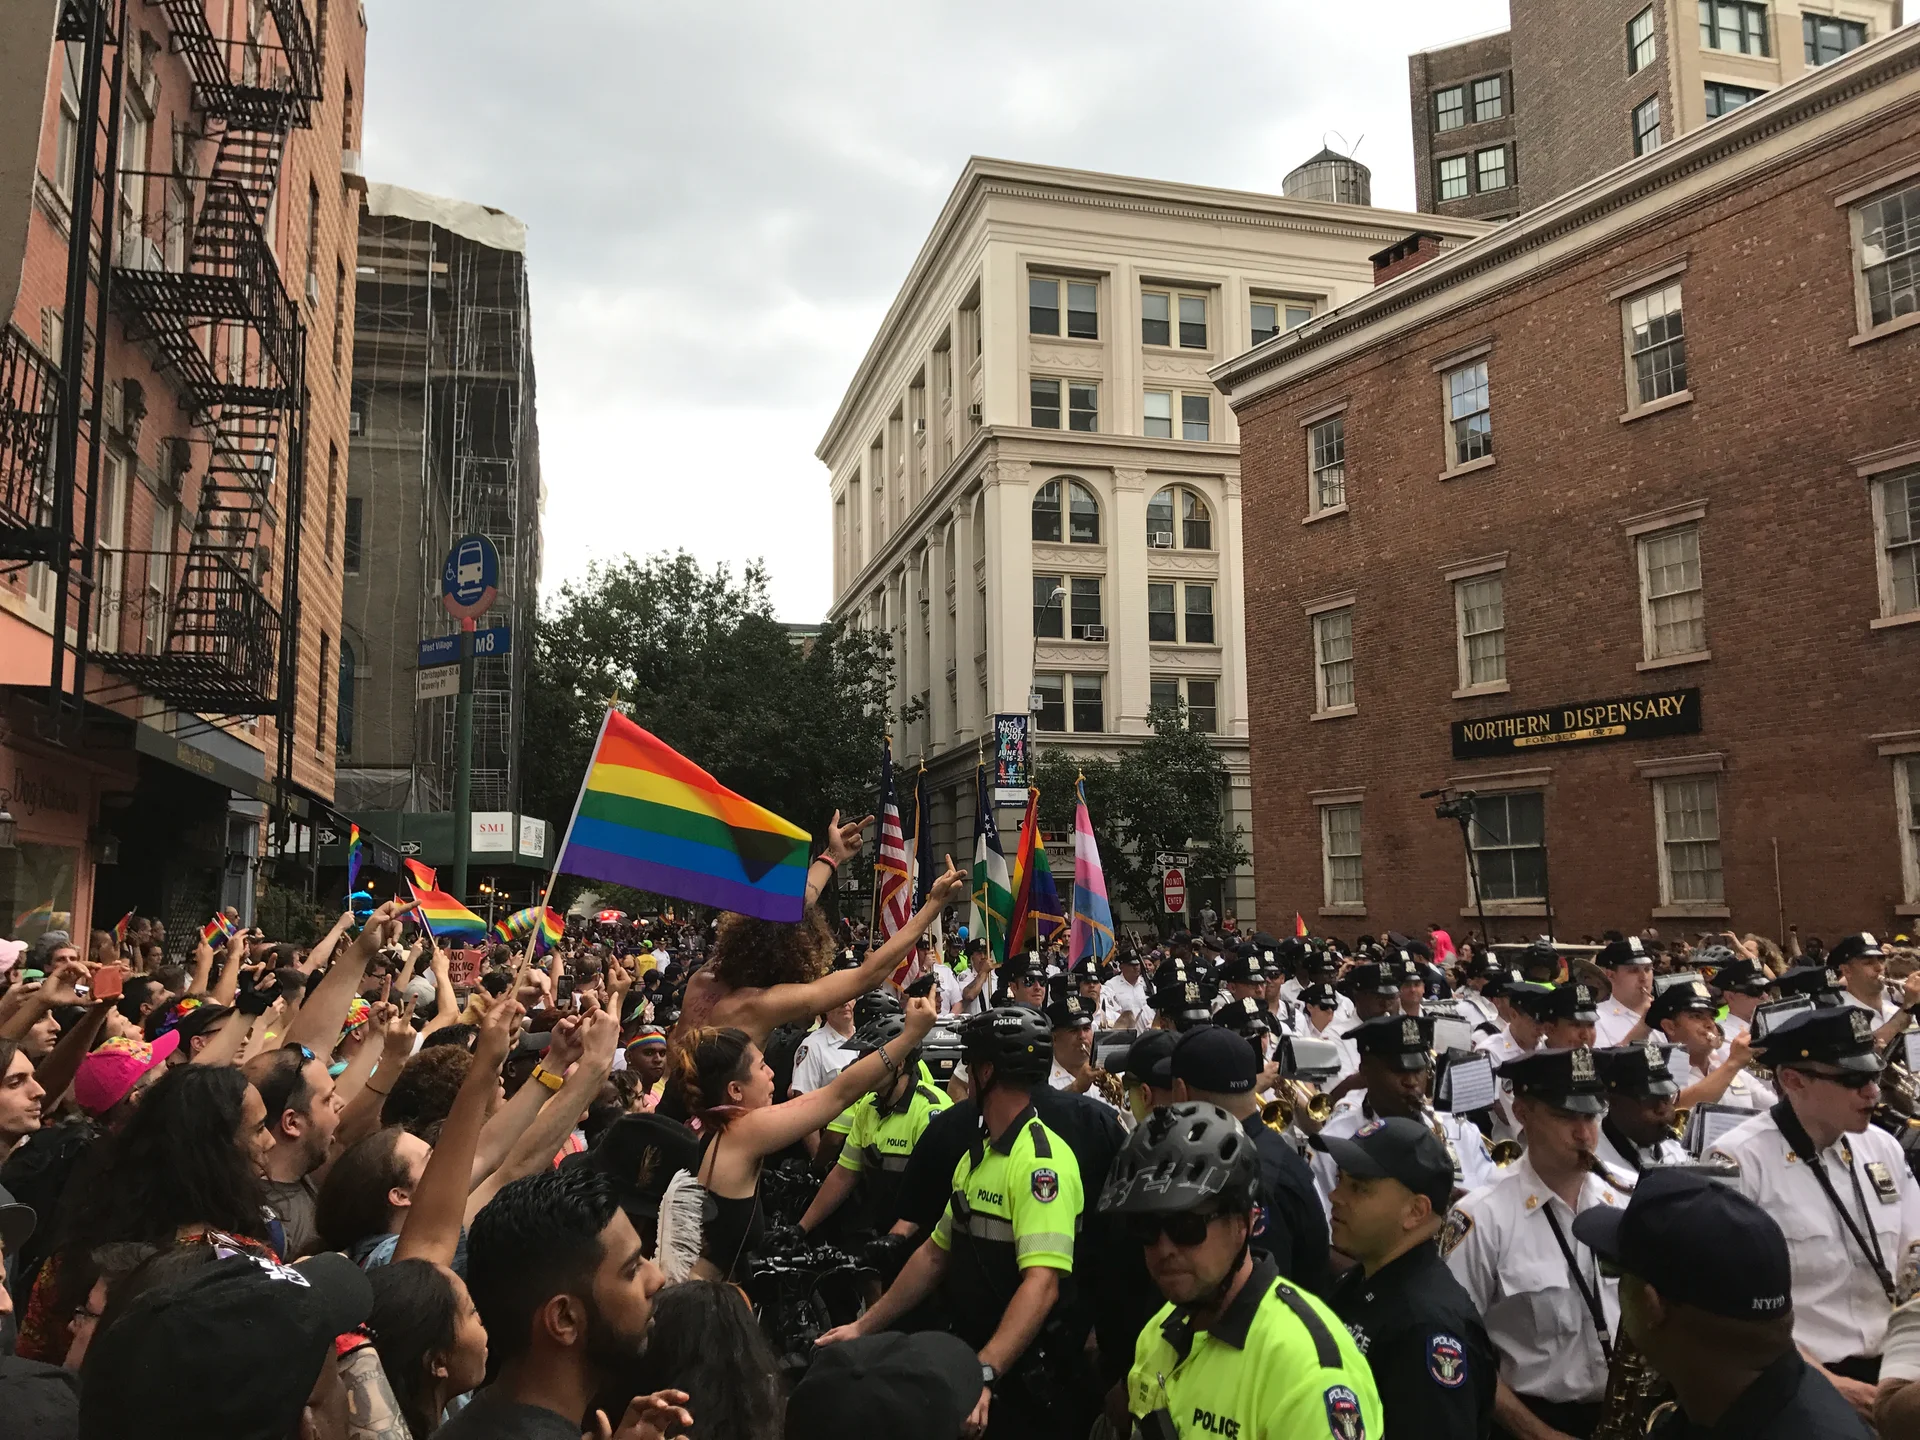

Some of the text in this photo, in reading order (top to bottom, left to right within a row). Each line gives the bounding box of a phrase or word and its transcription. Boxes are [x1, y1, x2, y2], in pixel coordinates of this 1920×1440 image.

[422, 640, 453, 652] West Village
[475, 633, 495, 653] M8
[421, 669, 448, 681] Christopher
[421, 681, 440, 691] Waverly
[1463, 695, 1686, 742] NORTHERN DISPENSARY
[998, 720, 1015, 729] NYC
[1008, 733, 1025, 741] 2017
[1525, 732, 1577, 745] FOUNDED
[479, 823, 505, 833] SMI
[1172, 877, 1182, 885] NOT
[1168, 897, 1182, 905] ENTER
[451, 951, 465, 961] NO
[993, 1018, 1023, 1026] POLICE
[932, 1030, 958, 1040] Pearl
[886, 1137, 908, 1148] POLICE
[1034, 1168, 1056, 1178] POLICE
[977, 1188, 1003, 1206] POLICE
[1752, 1294, 1786, 1310] NYPD
[1432, 1335, 1463, 1353] POLICE
[1328, 1387, 1357, 1405] POLICE
[1192, 1407, 1242, 1440] POLICE
